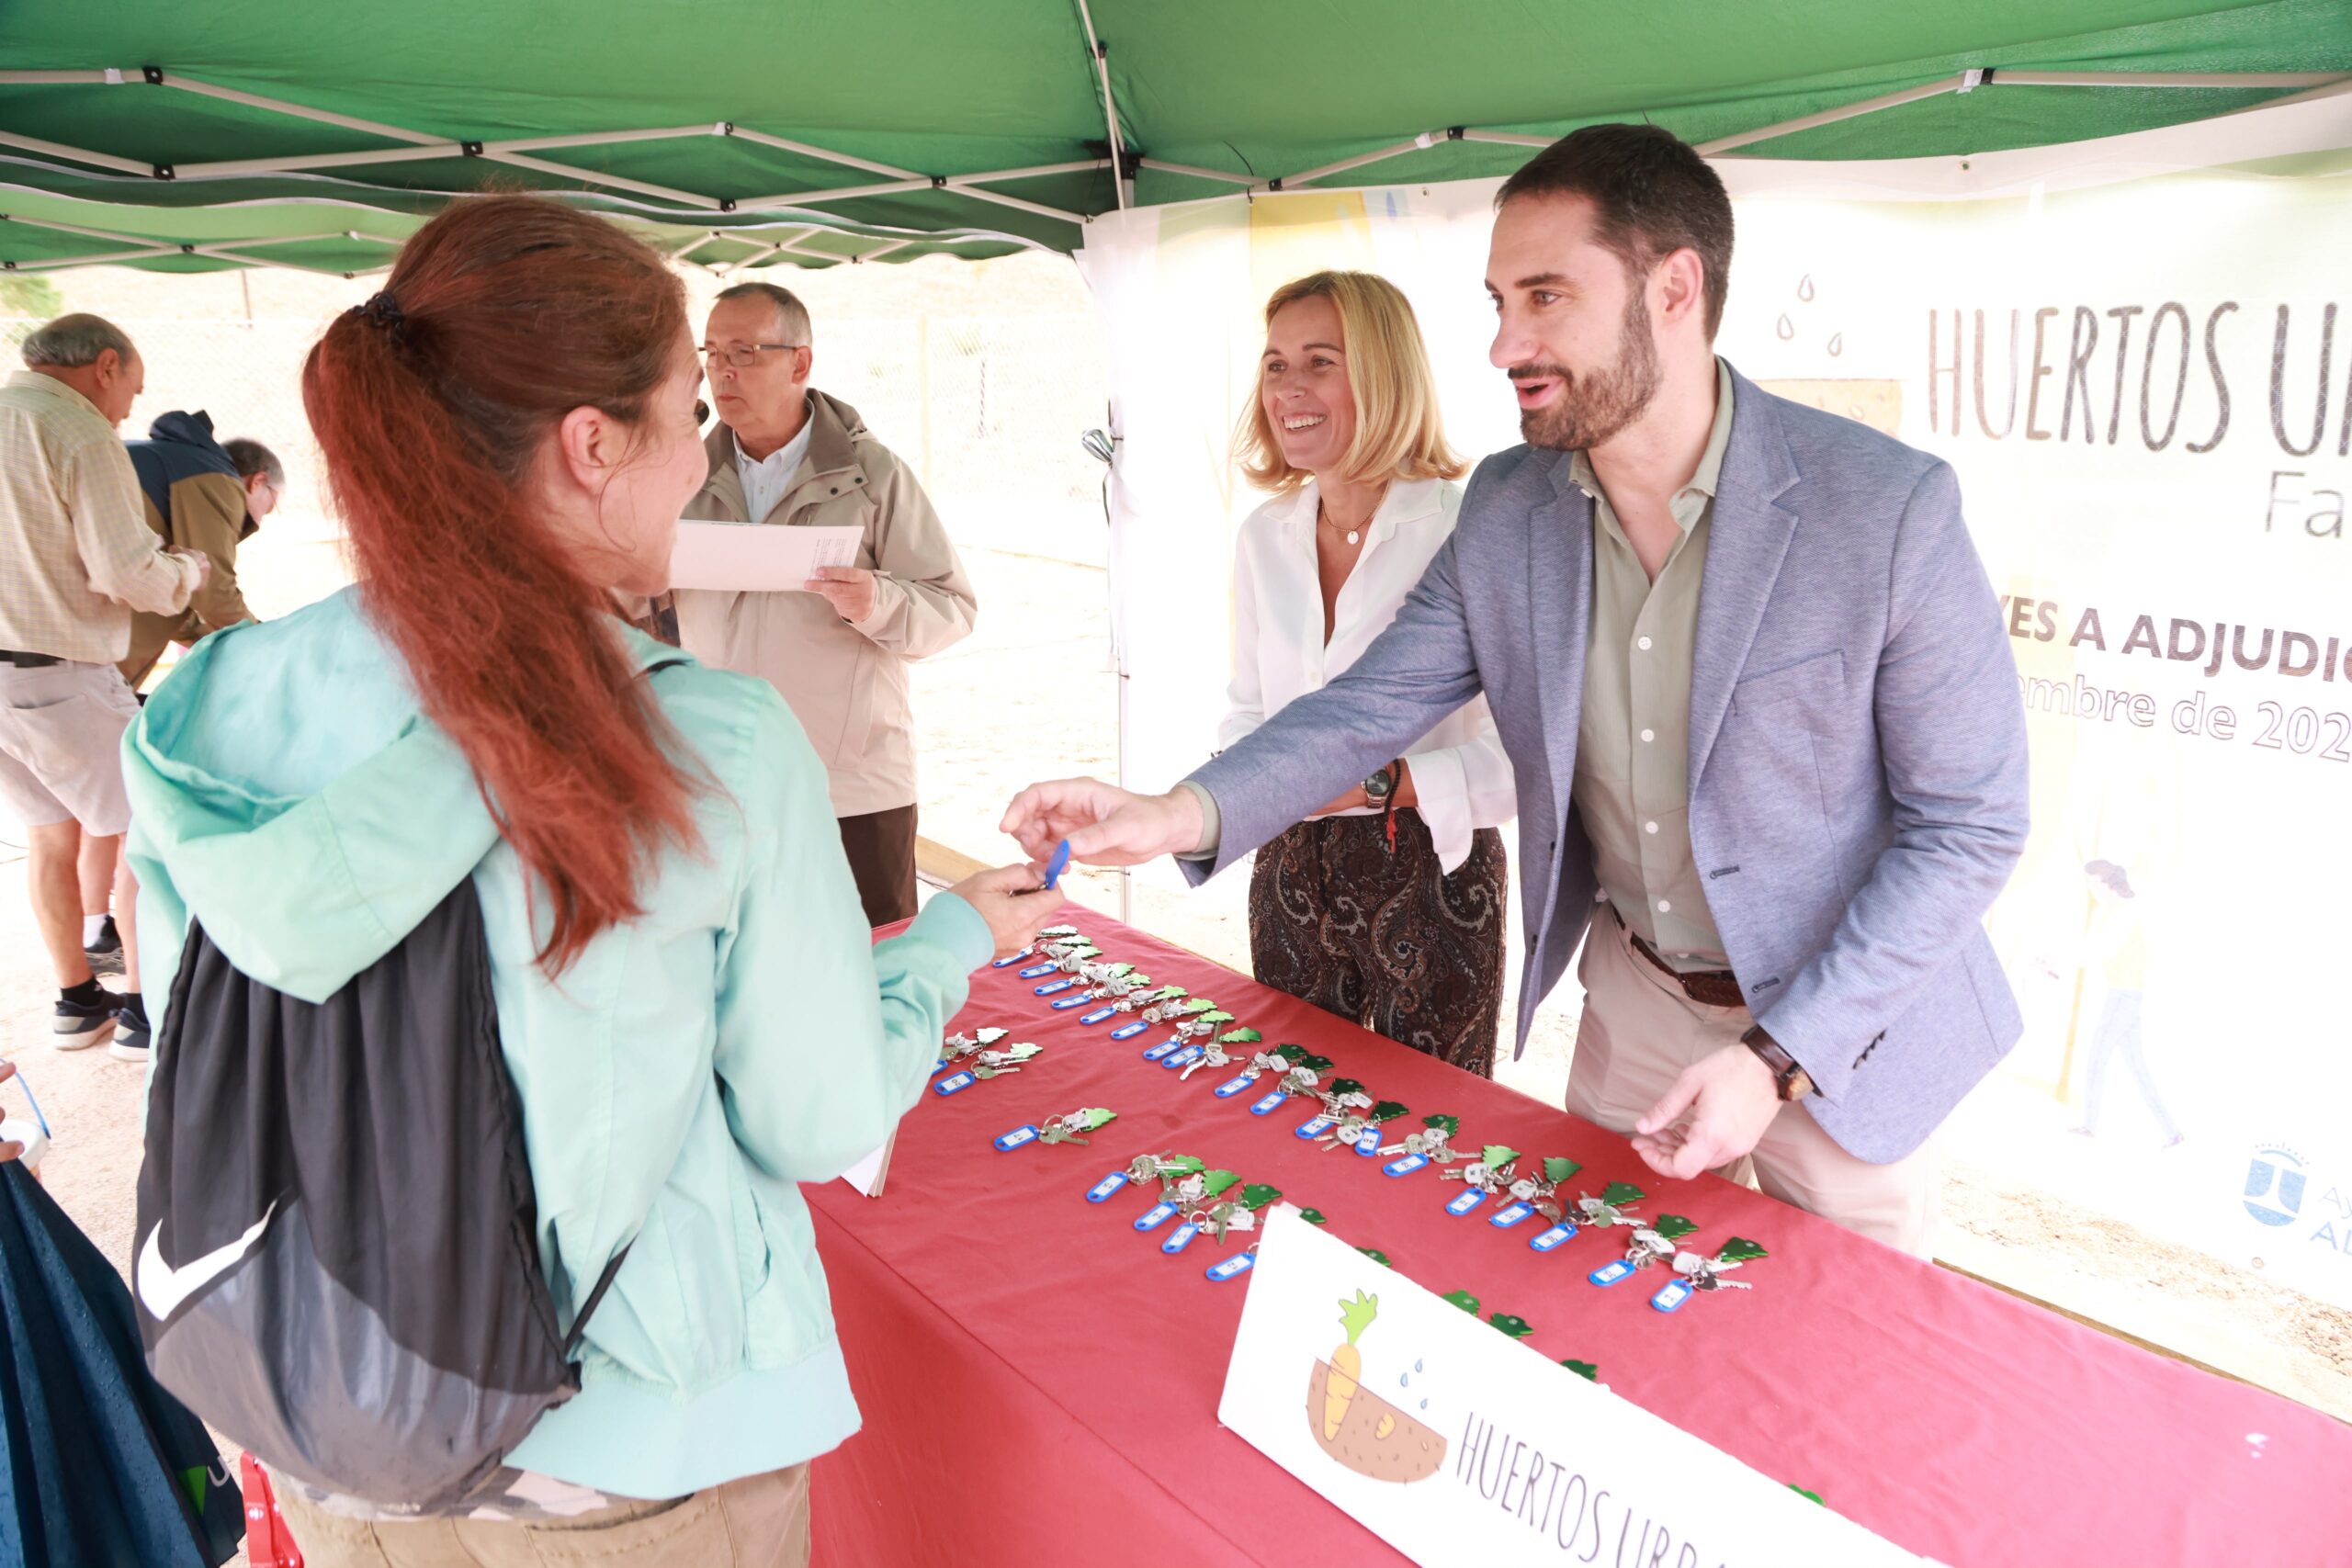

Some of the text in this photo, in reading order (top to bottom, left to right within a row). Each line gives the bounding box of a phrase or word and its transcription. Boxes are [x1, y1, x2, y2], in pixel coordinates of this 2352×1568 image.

[1929, 301, 2352, 457] HUERTOS U
[2266, 469, 2345, 538] Fa
[1997, 594, 2352, 682] ES A ADJUDI
[2171, 691, 2237, 740] de
[2252, 700, 2351, 763] 202
[1457, 1411, 1611, 1562] HUERTOS
